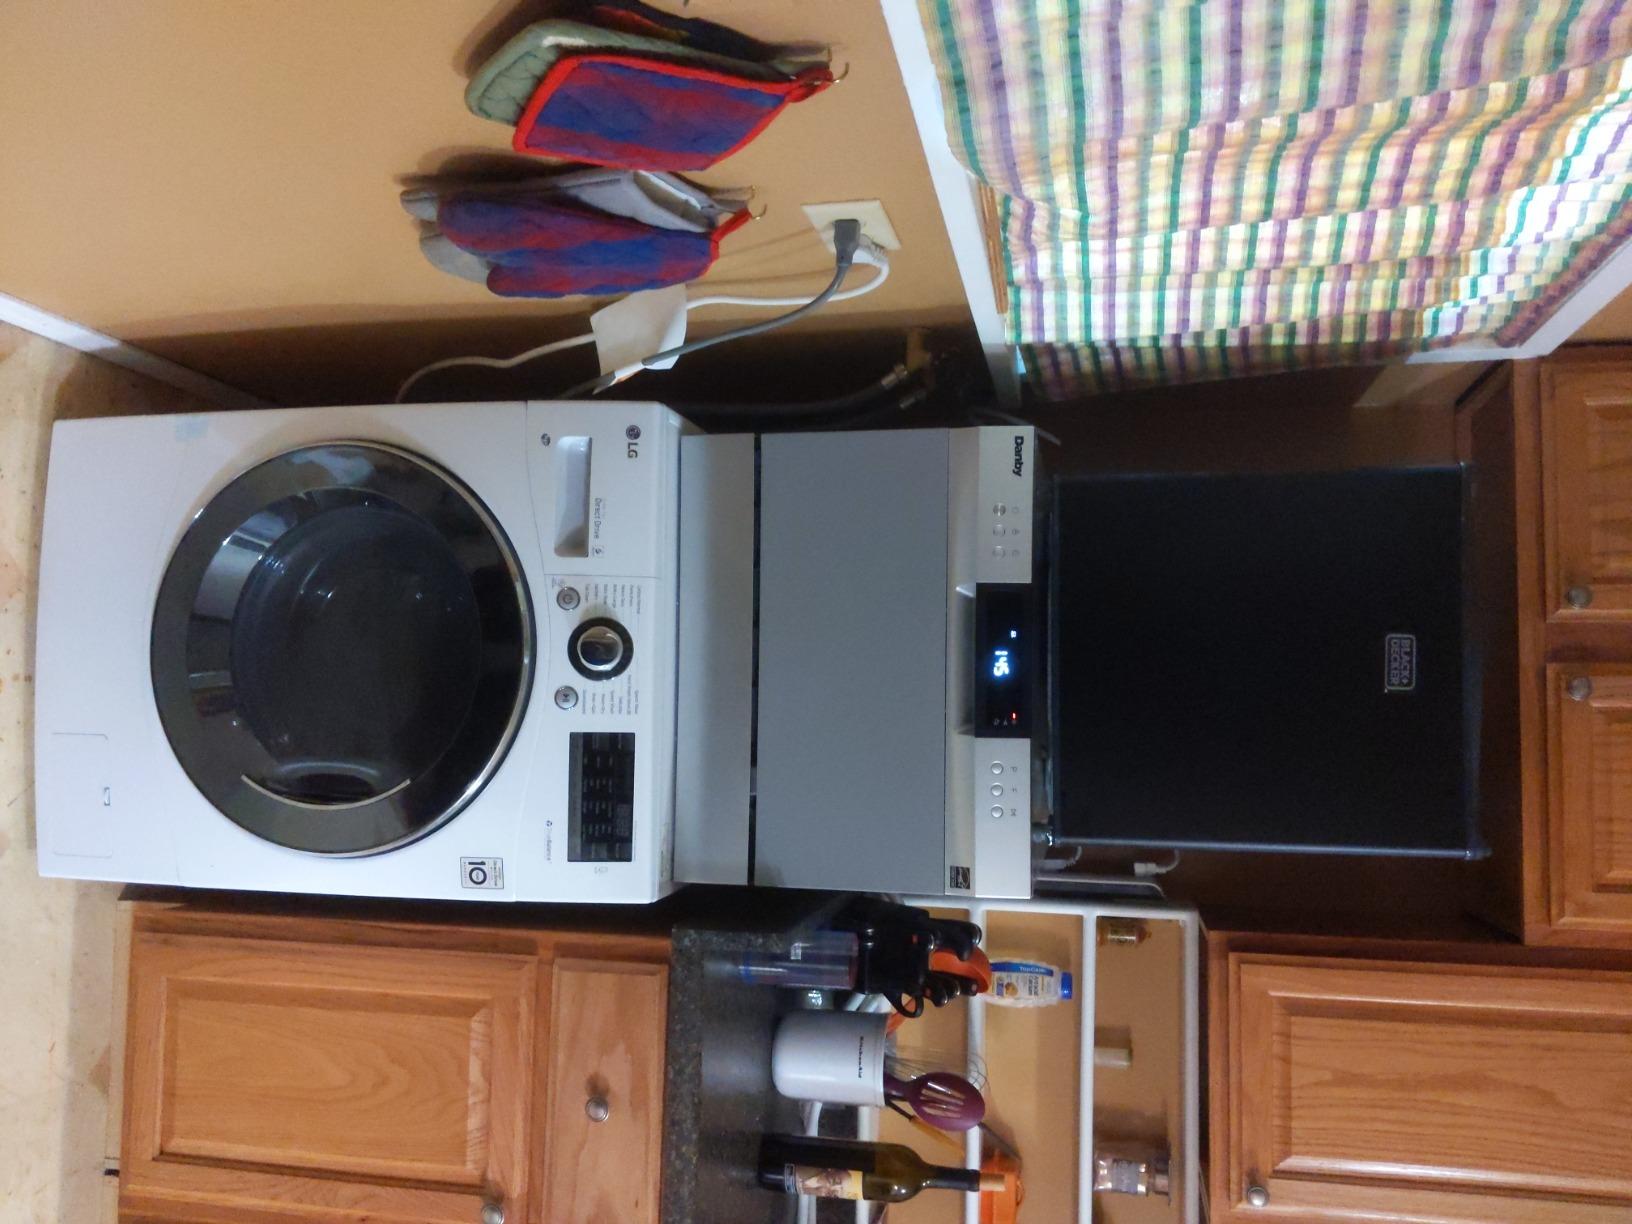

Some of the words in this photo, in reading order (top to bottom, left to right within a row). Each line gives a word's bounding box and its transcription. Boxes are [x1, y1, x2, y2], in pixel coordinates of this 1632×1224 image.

[627, 442, 638, 459] LG
[1012, 435, 1025, 477] Danby
[593, 497, 603, 519] Direct
[593, 520, 603, 540] Drive
[993, 649, 1010, 677] 145
[1390, 638, 1400, 685] DECKER
[468, 860, 488, 885] 10
[857, 1035, 865, 1079] KitchenAid
